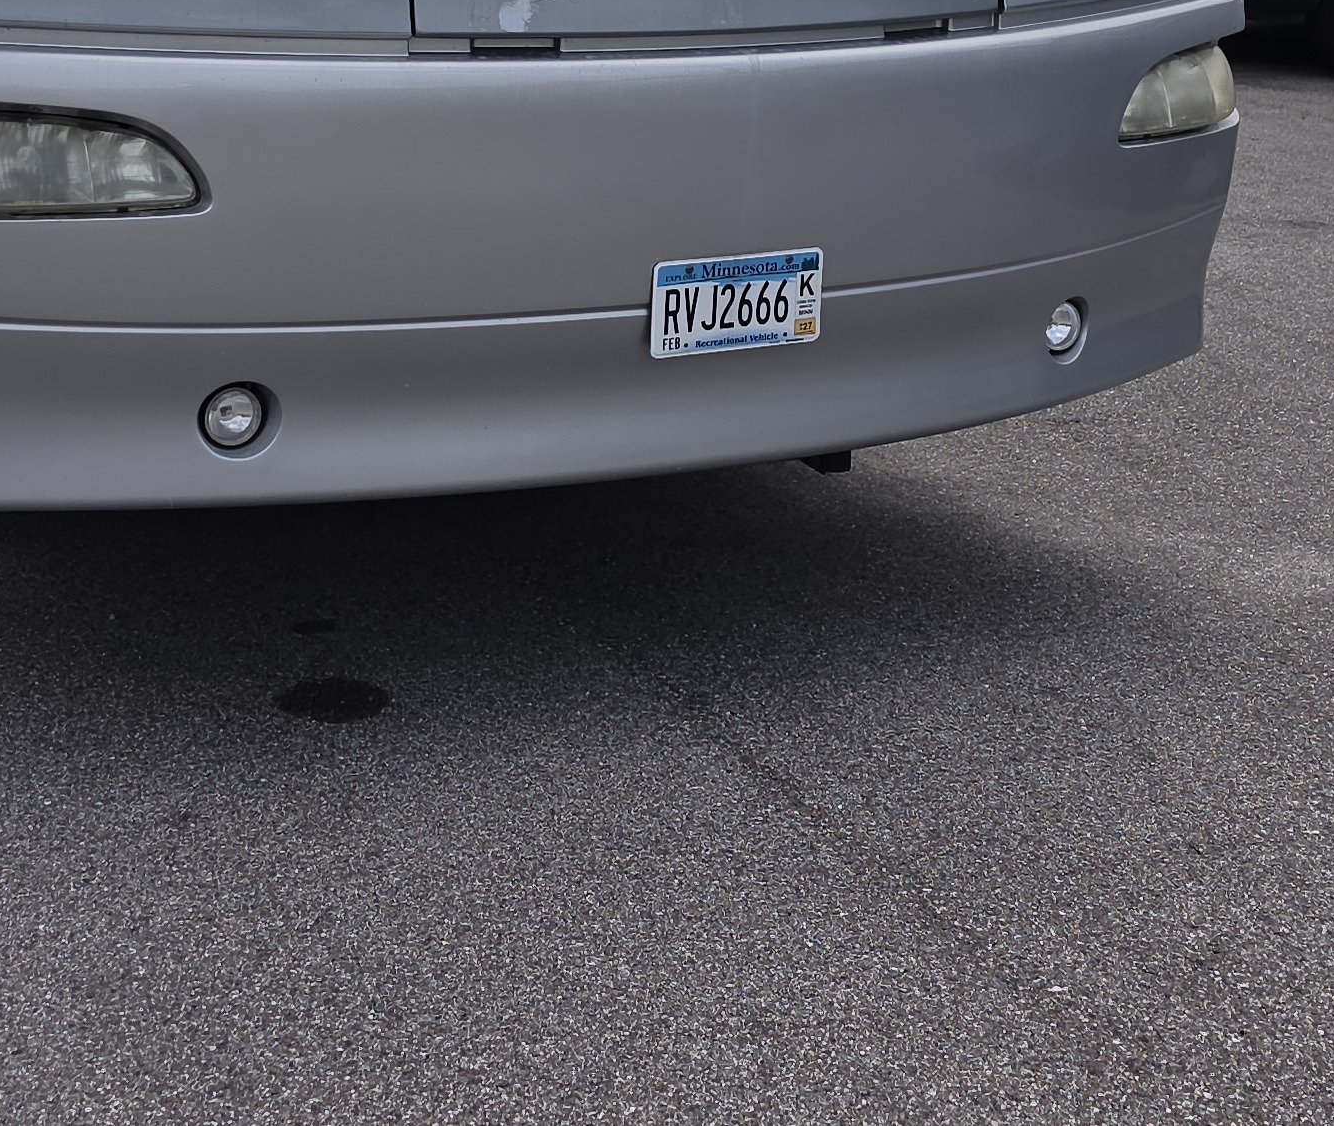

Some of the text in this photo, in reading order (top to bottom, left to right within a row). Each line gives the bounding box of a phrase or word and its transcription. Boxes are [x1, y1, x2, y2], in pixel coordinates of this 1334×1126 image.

[799, 273, 815, 296] K
[663, 278, 789, 336] RVJ2666
[662, 337, 681, 352] FEB
[695, 332, 779, 349] Recreational Vehicle
